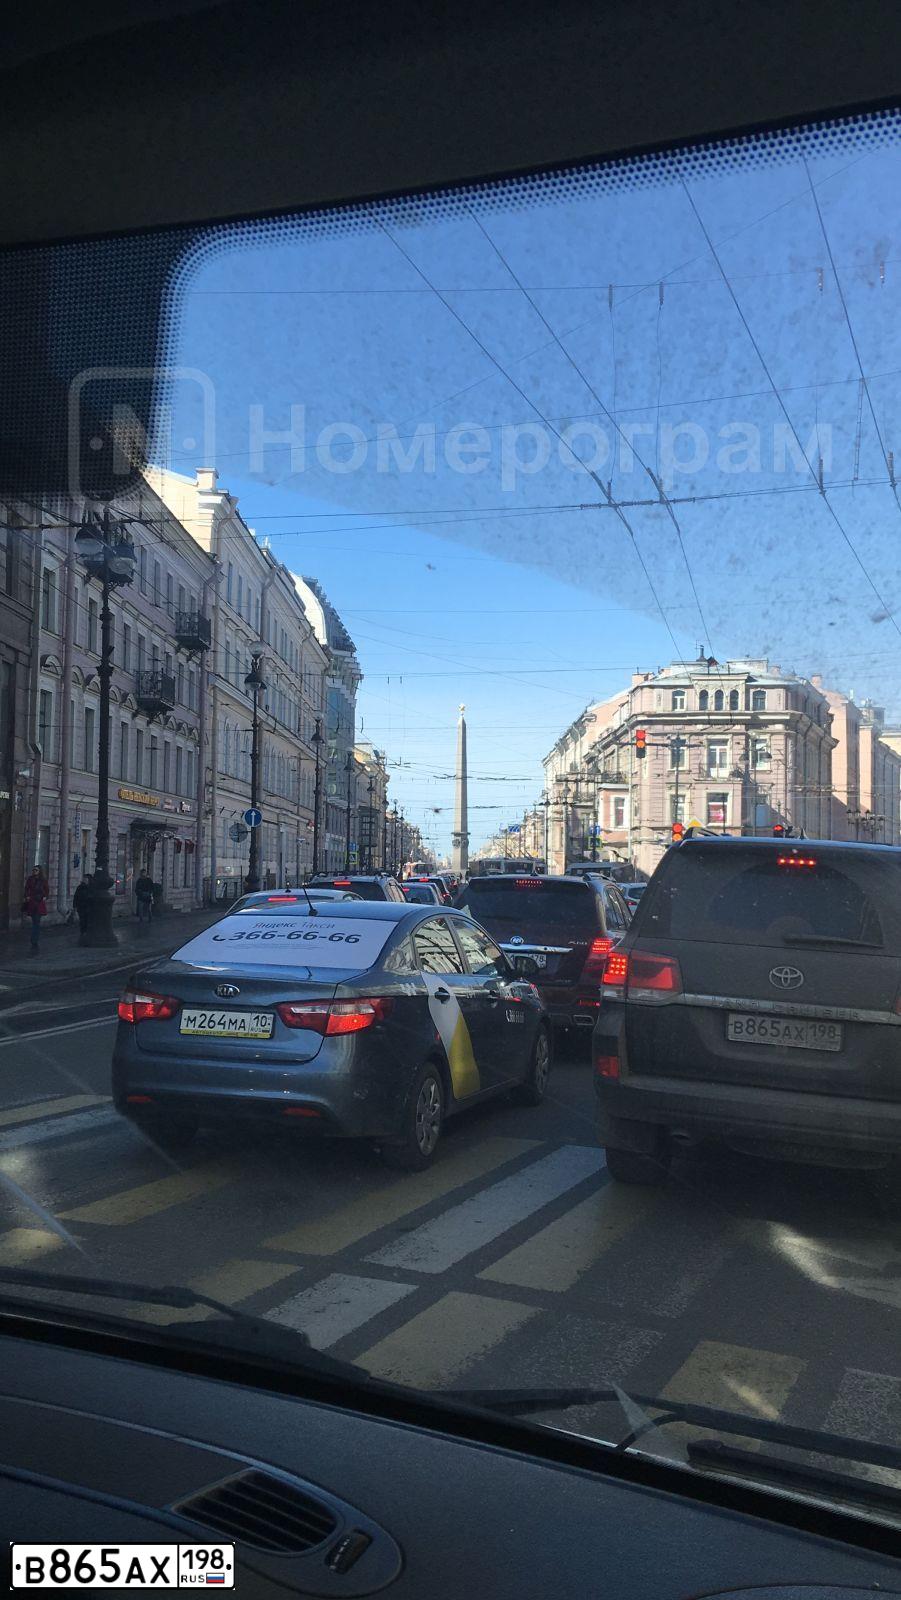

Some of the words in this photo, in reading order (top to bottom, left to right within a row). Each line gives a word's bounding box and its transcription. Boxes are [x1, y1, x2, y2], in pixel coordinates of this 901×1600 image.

[228, 930, 361, 943] 366-66-66
[216, 987, 235, 996] KIA
[772, 1002, 864, 1019] CRUISER
[186, 1013, 246, 1031] М264МА
[253, 1015, 267, 1027] 10
[733, 1018, 804, 1041] В865АХ
[809, 1024, 836, 1039] 198
